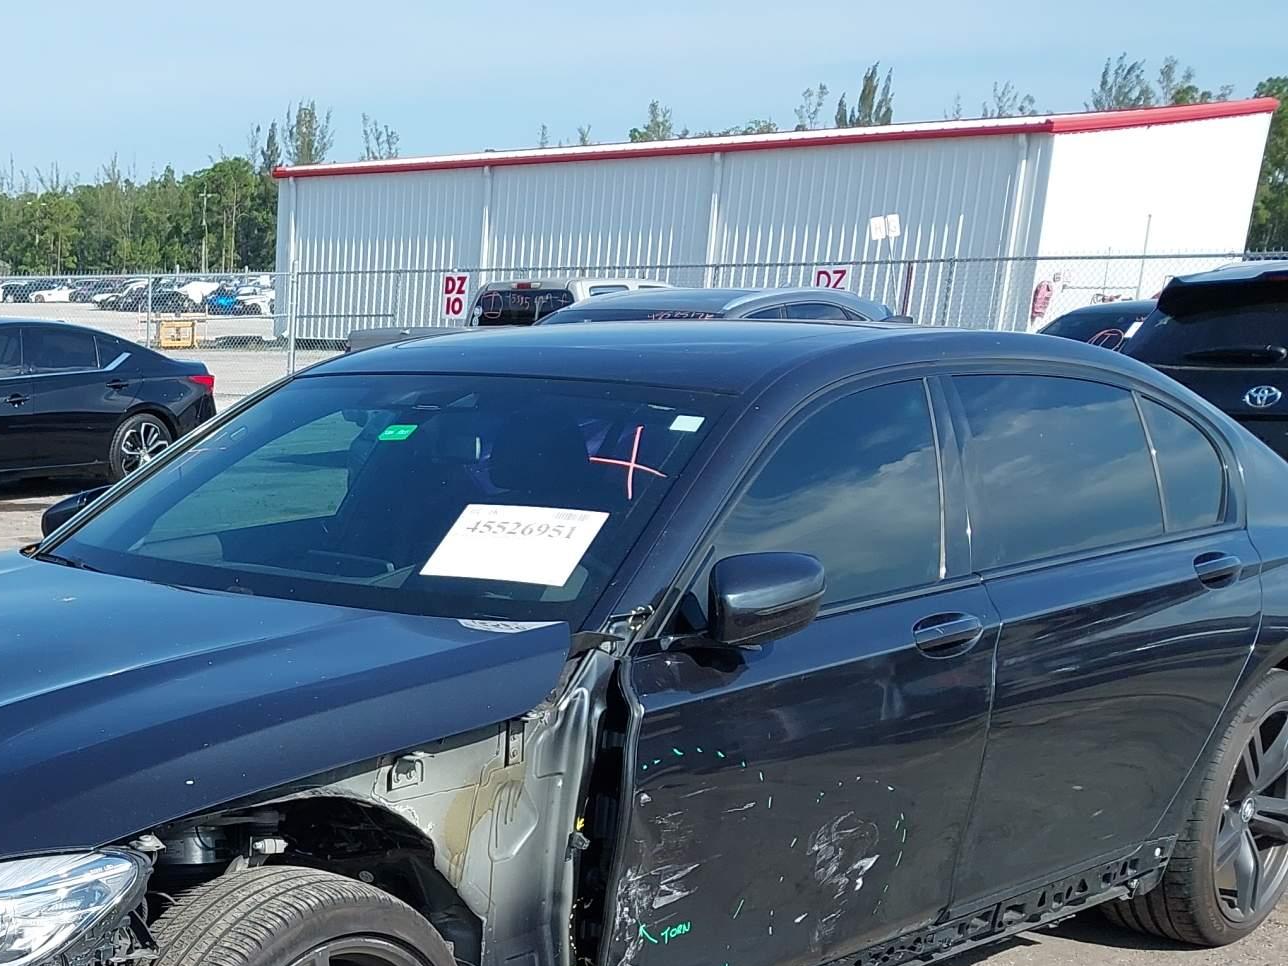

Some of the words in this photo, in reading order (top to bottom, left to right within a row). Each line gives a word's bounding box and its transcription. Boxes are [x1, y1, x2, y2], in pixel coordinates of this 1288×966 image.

[445, 276, 467, 294] DZ
[816, 269, 847, 290] DZ
[465, 519, 577, 540] 45526951
[660, 921, 691, 945] TORN
